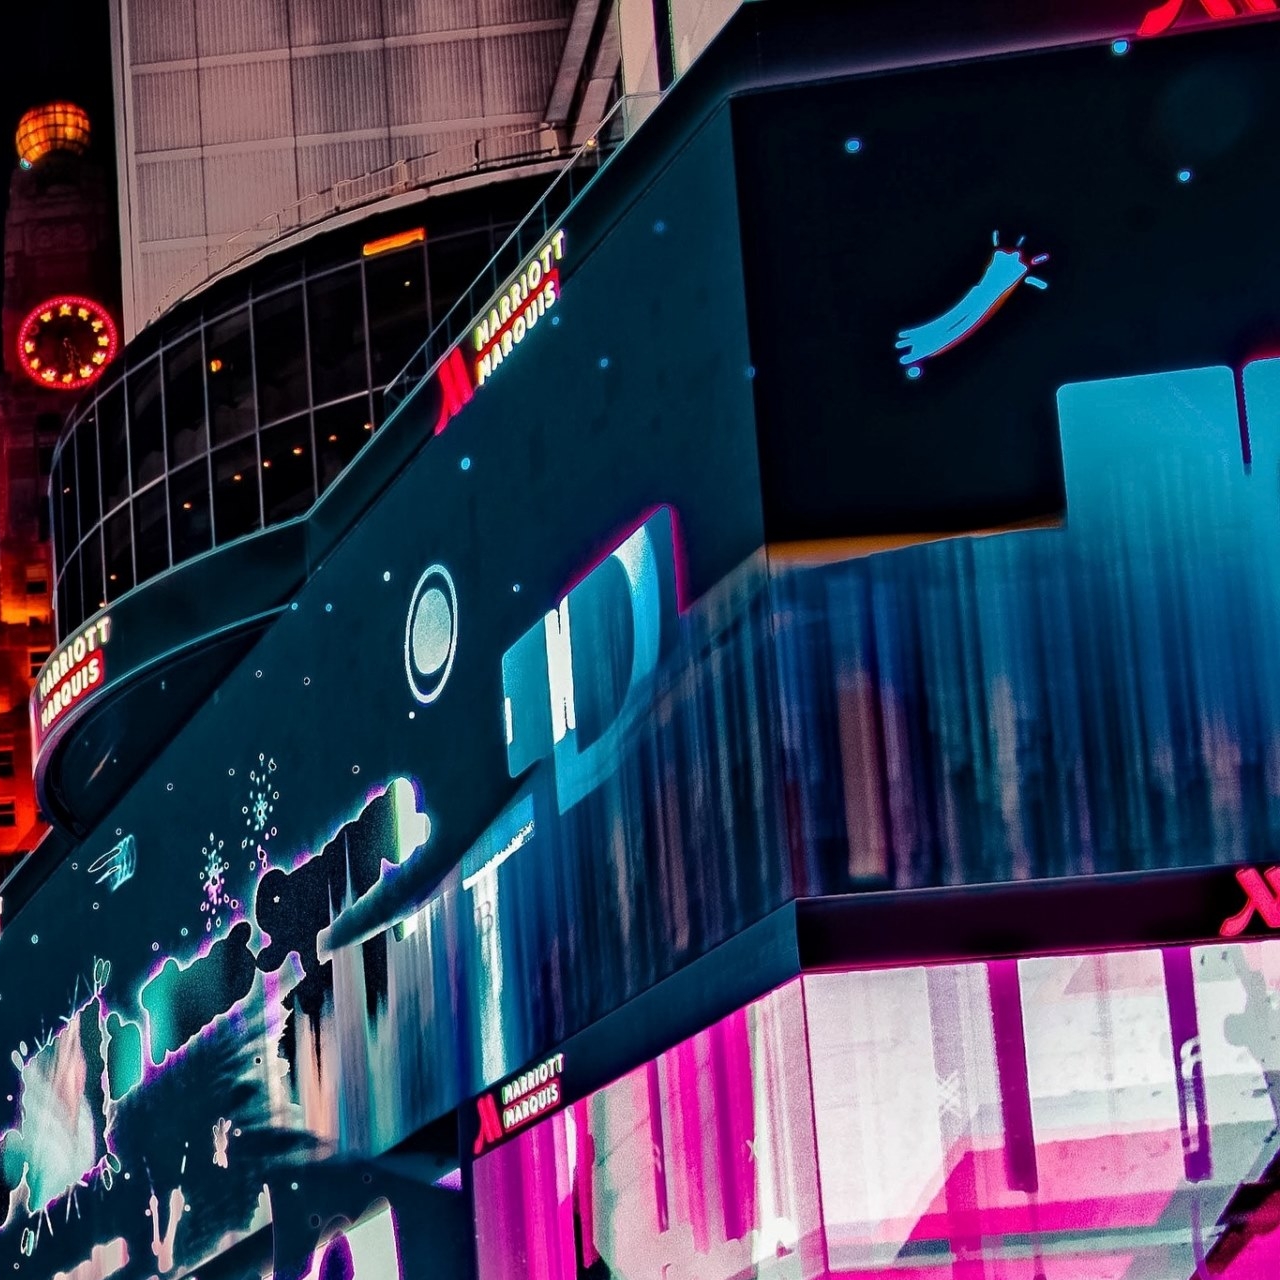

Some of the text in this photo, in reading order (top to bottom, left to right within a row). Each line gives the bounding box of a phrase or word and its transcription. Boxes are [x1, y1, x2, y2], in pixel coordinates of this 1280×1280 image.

[474, 229, 565, 351] MARRIOTT
[477, 280, 555, 385] MARQUIS
[39, 616, 110, 702] MARRIOTT
[41, 658, 100, 731] MARQUIS
[502, 1053, 563, 1105] MARRIOTT
[503, 1083, 558, 1128] MARQUIS
